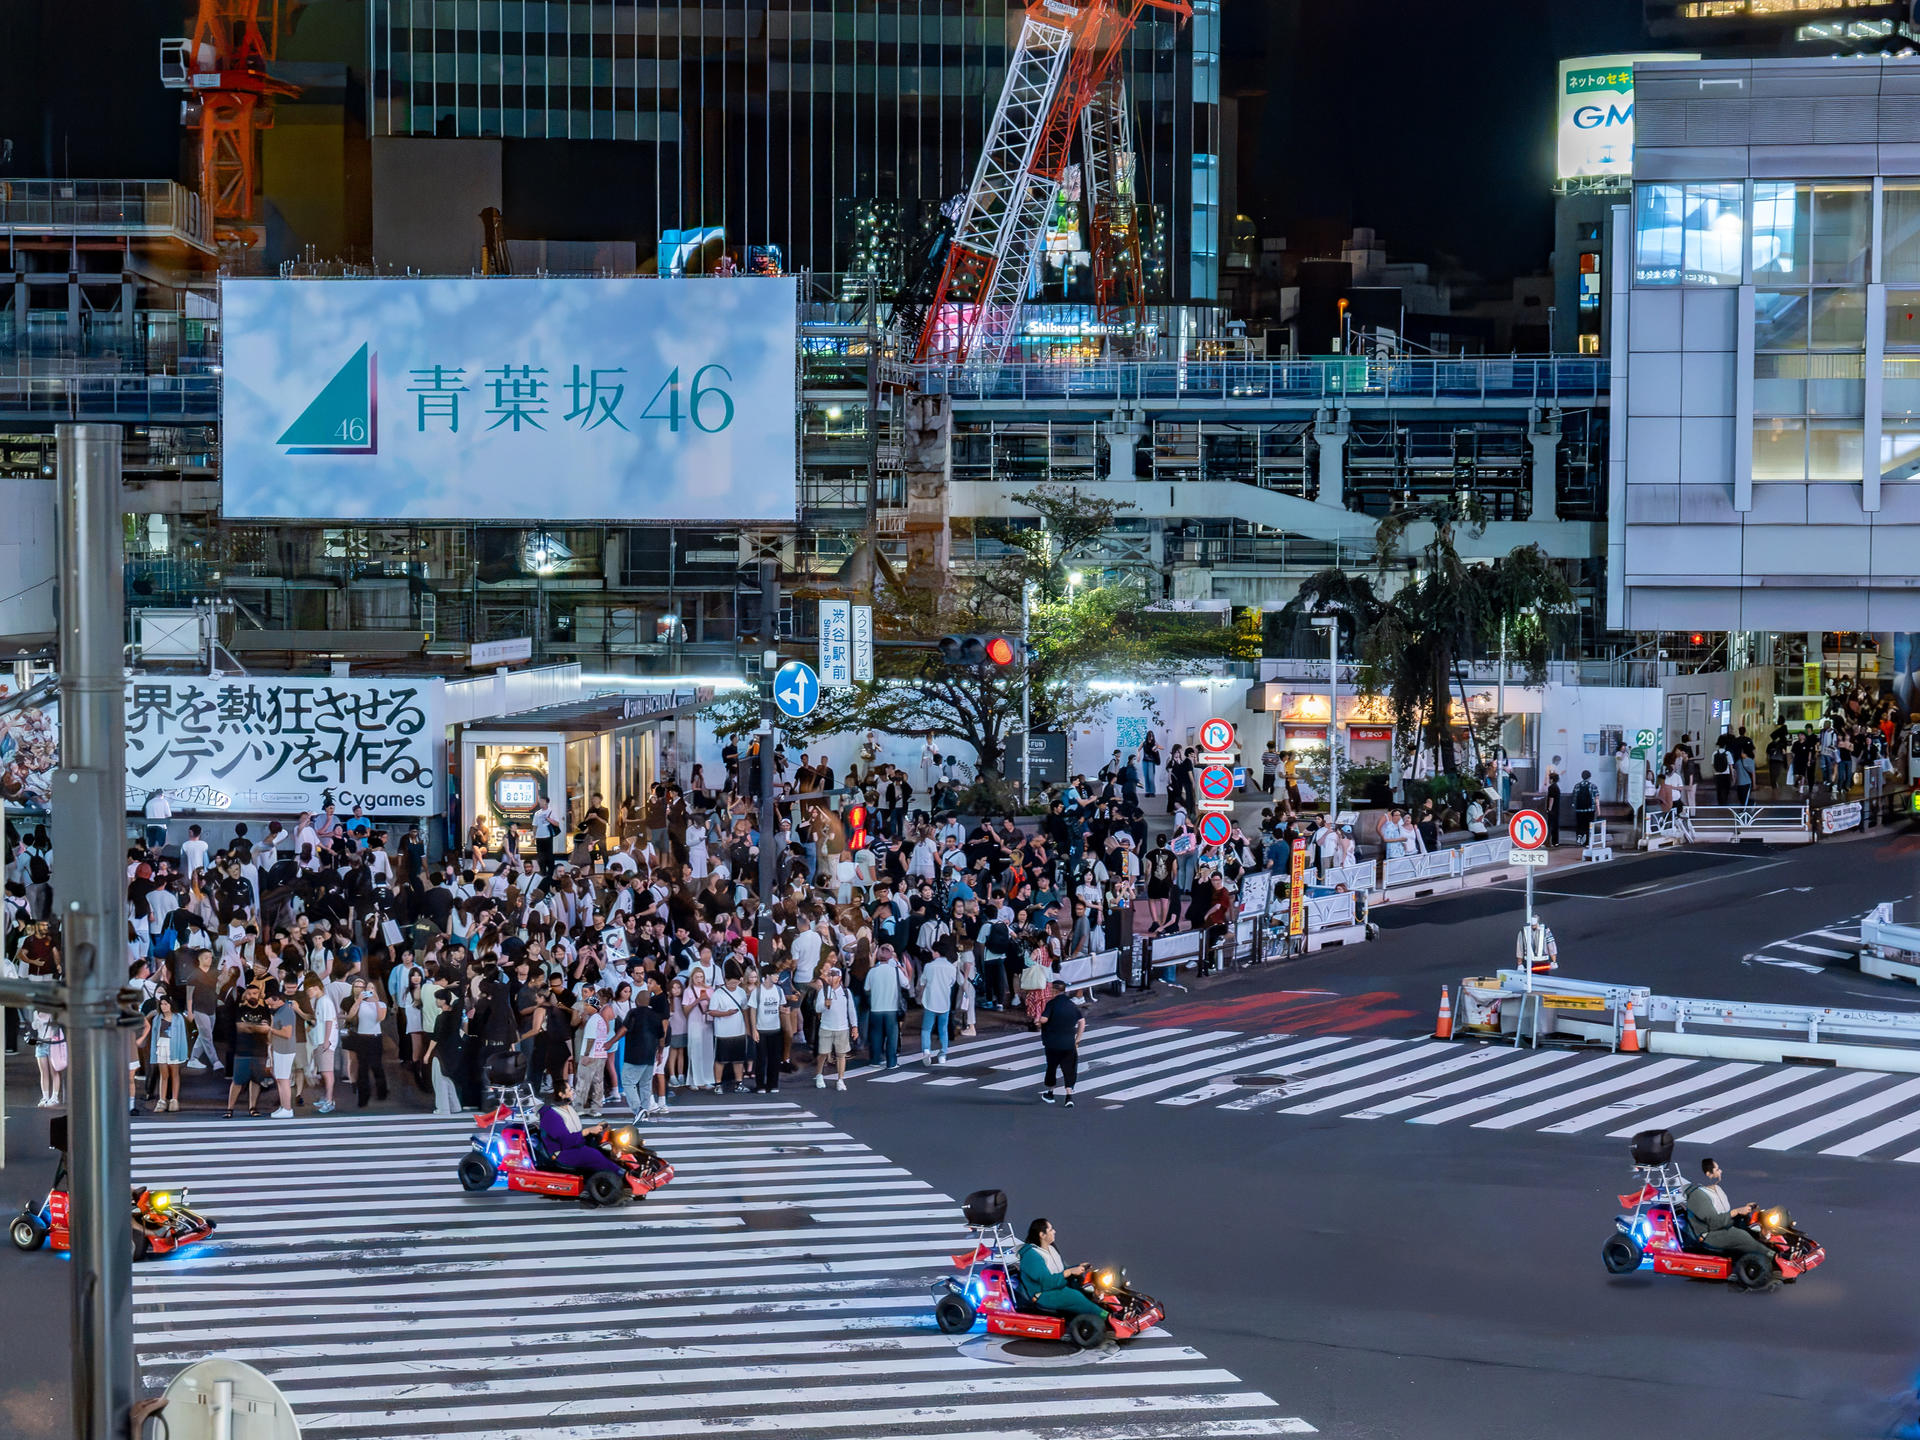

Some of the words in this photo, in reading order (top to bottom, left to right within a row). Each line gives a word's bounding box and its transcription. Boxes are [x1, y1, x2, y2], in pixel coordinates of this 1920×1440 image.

[406, 364, 735, 433] 青葉坂46
[334, 417, 365, 441] 46
[823, 619, 831, 651] Shibuya
[832, 608, 846, 680] 渋谷駅前
[857, 609, 868, 677] スクランブル式
[125, 684, 426, 735] 界を熱狂させる
[1638, 731, 1655, 746] 29
[125, 731, 433, 788] ンテンツを作る。
[338, 790, 426, 810] Cygames
[1511, 853, 1545, 863] ここまで
